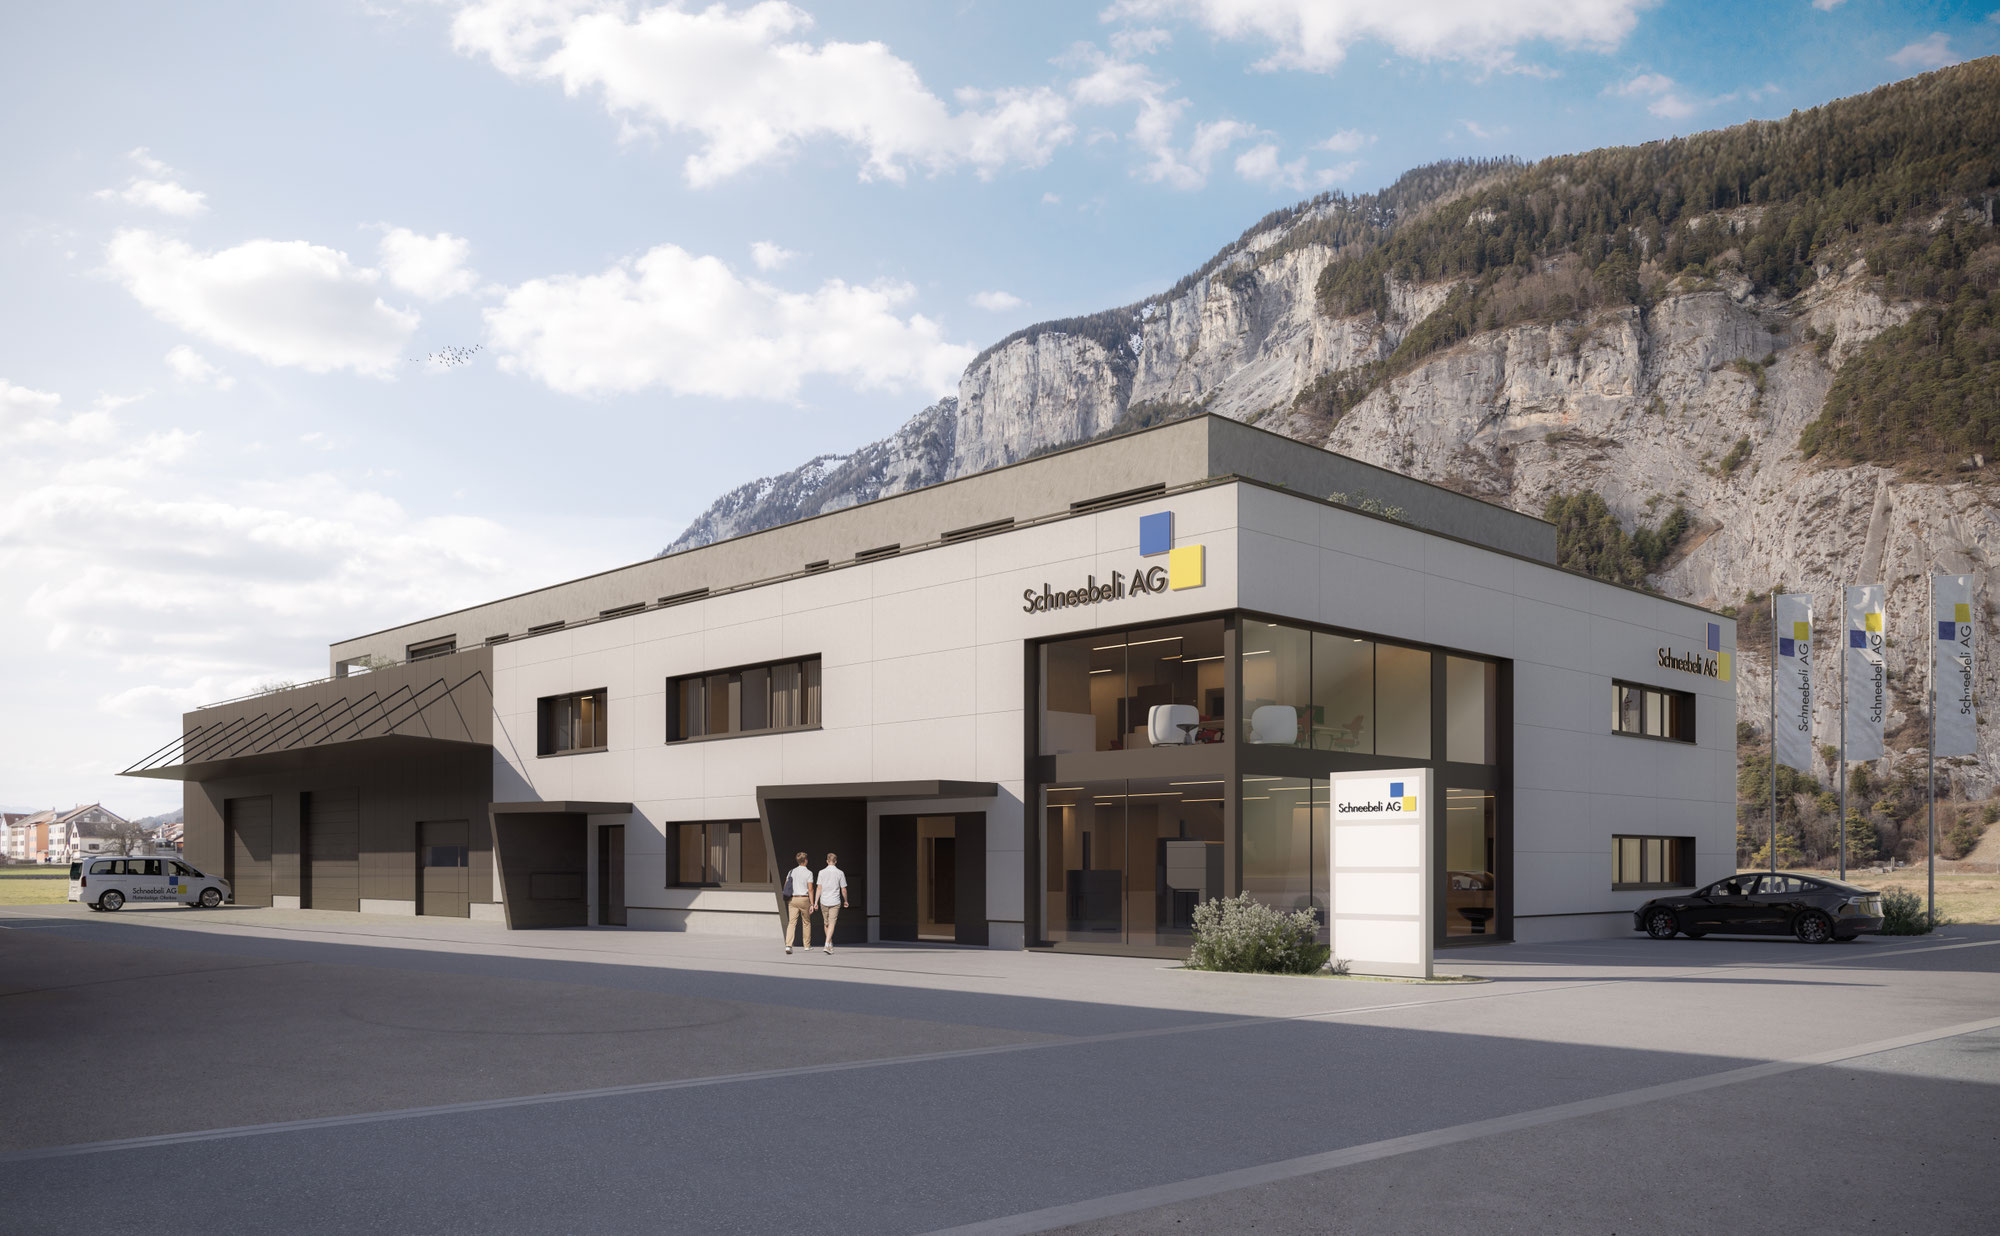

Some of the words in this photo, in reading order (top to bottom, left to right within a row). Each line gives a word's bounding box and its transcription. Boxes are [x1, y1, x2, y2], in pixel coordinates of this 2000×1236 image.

[1023, 570, 1125, 613] Schneebeli
[1129, 565, 1168, 597] AG
[1871, 634, 1883, 656] AG
[1960, 625, 1972, 648] AG
[1657, 647, 1701, 675] Schneebeli
[1703, 657, 1718, 678] AG
[1798, 643, 1809, 666] AG
[1870, 660, 1883, 723] Schneebeli
[1959, 652, 1972, 715] Schneebeli
[1798, 669, 1810, 732] Schneebeli
[1338, 801, 1383, 813] Schneebeli
[1386, 801, 1402, 812] AG
[132, 887, 165, 895] Schneebeli
